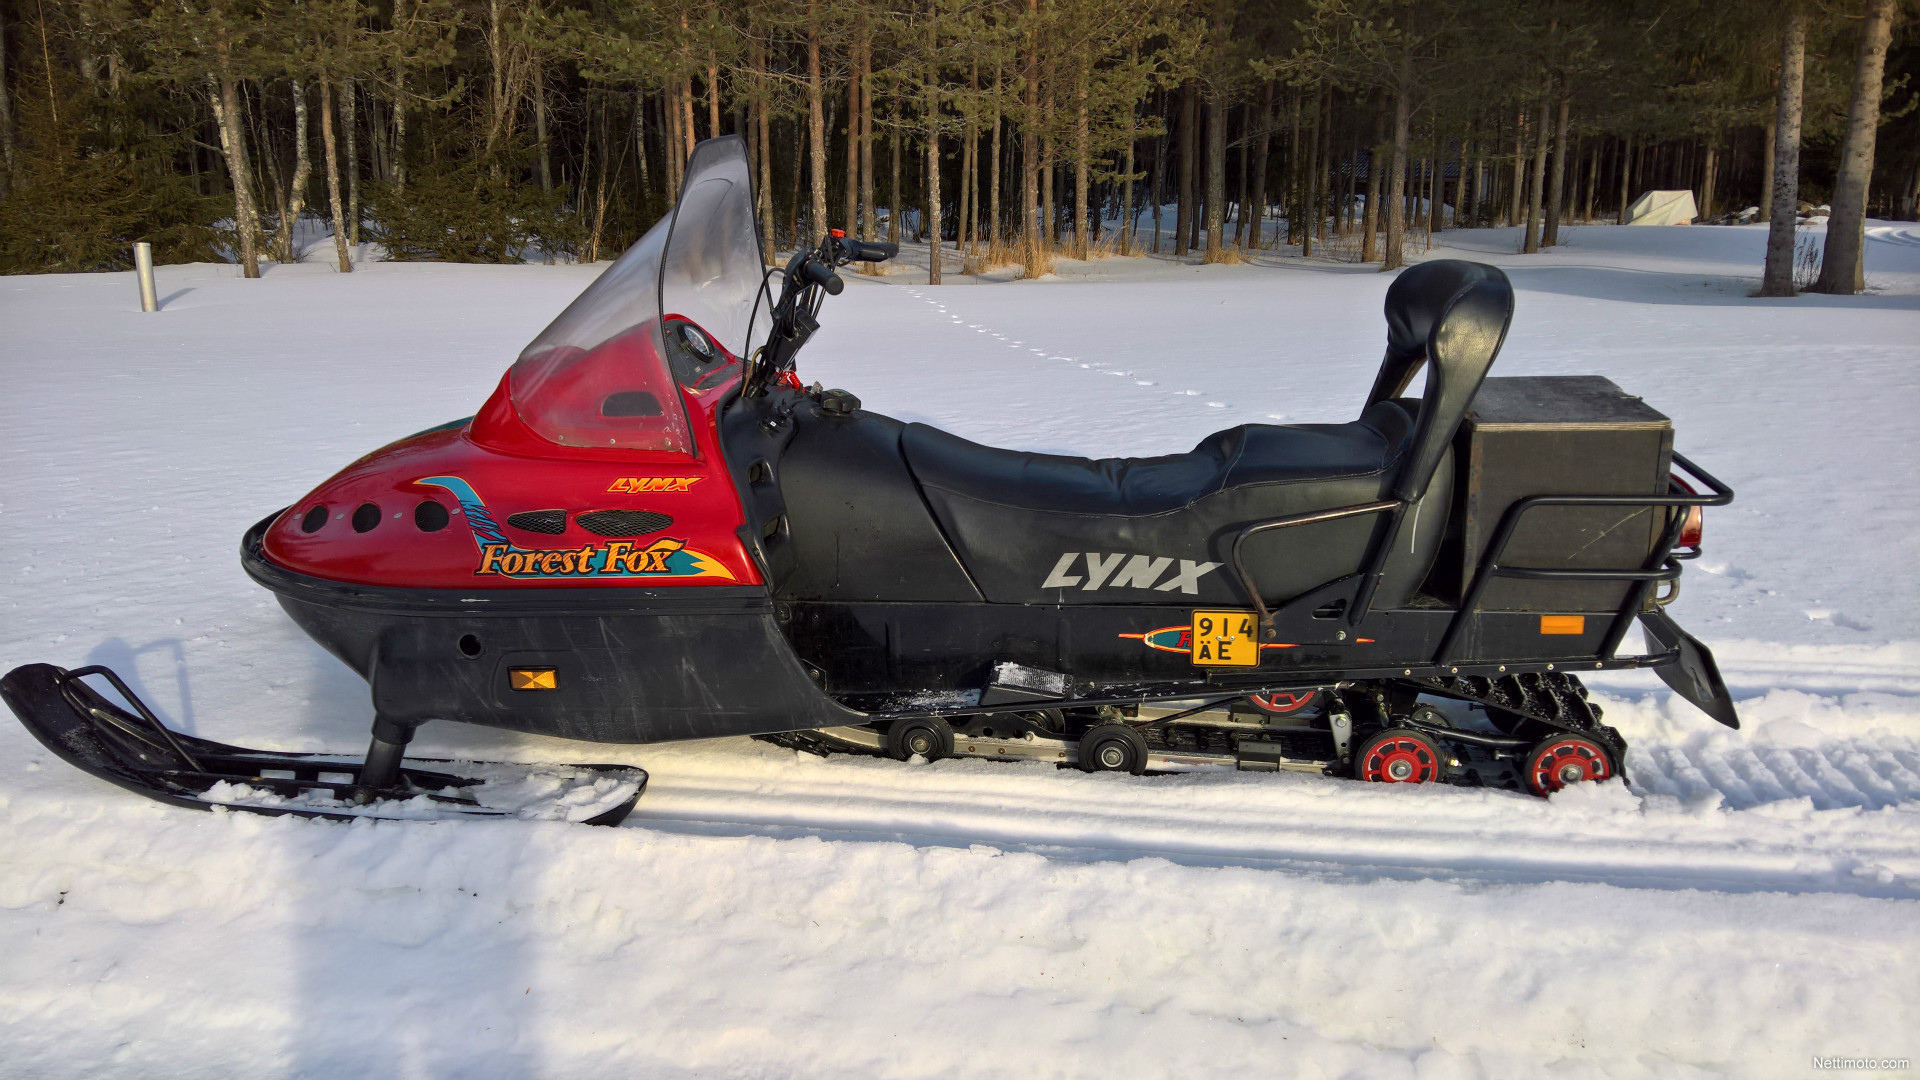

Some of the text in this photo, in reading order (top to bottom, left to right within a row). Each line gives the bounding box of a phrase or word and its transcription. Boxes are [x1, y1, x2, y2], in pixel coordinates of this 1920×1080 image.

[605, 477, 703, 494] LYNX
[474, 537, 687, 576] Forest Fox
[1041, 552, 1226, 595] LYNX
[1199, 617, 1254, 638] 914
[1198, 640, 1232, 661] ÄE
